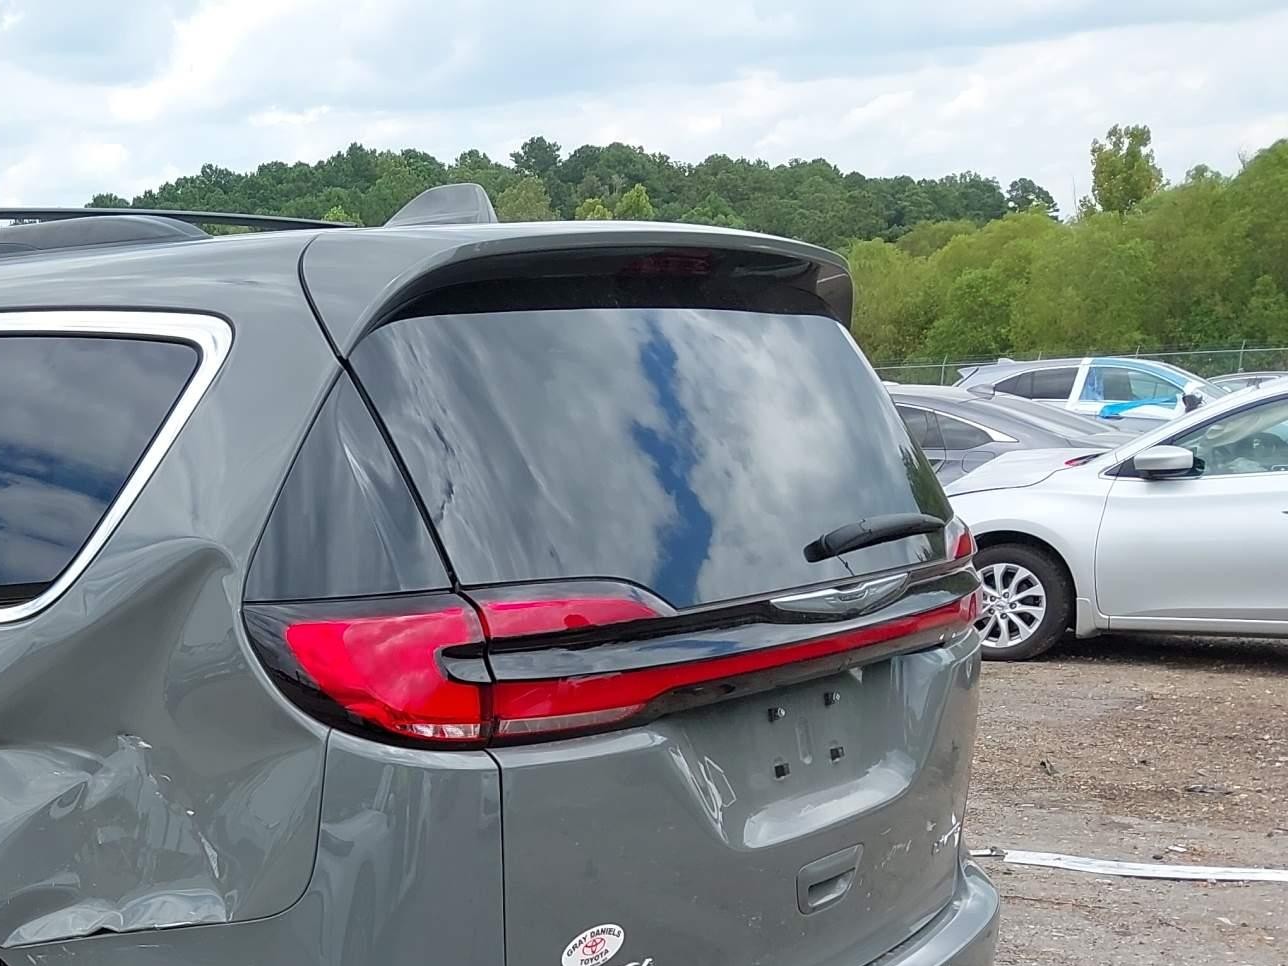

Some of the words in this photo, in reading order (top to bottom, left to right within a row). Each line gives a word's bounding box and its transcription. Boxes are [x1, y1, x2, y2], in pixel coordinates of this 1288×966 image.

[566, 934, 589, 957] GRAY
[589, 927, 622, 939] DANIELS
[579, 948, 610, 966] TOYOTA
